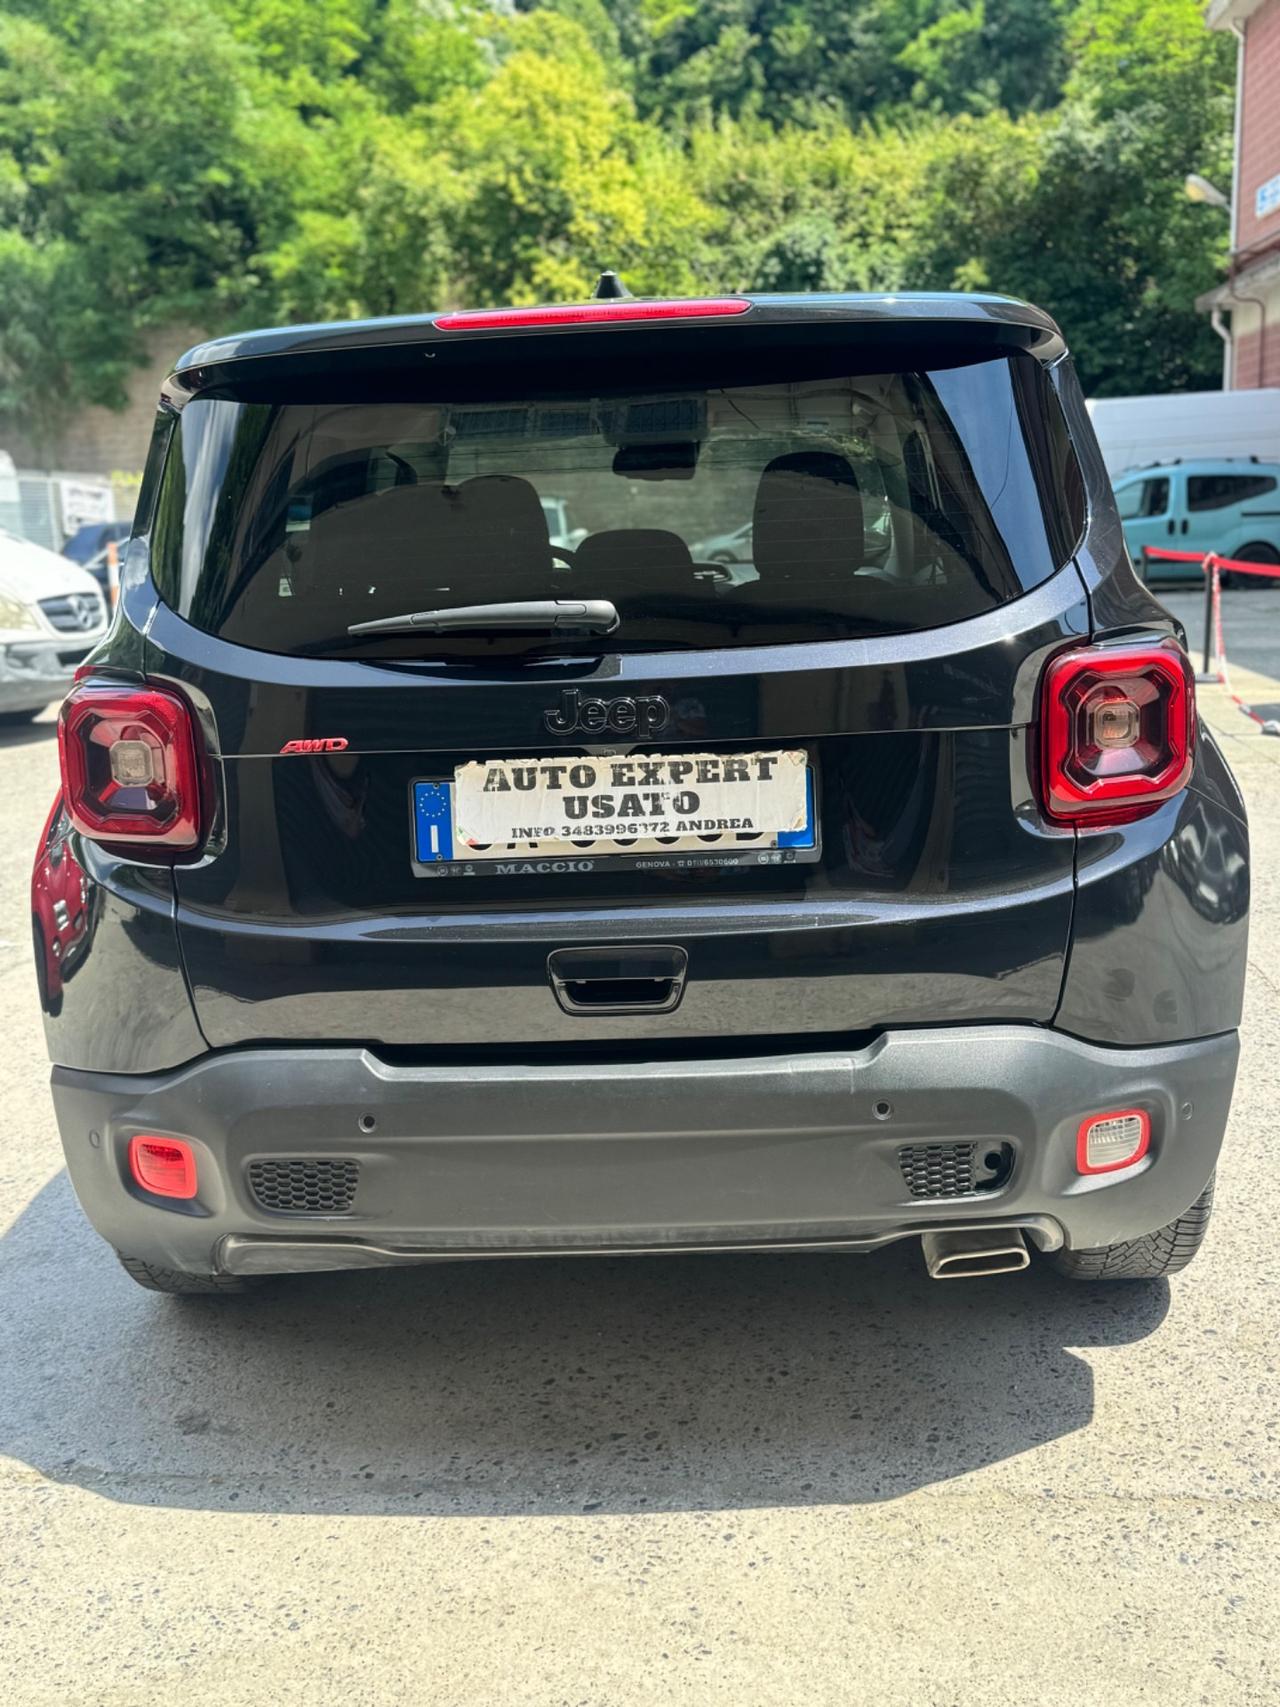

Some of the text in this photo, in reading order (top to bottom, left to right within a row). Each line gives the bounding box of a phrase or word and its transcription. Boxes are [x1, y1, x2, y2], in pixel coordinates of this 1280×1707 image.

[544, 689, 670, 738] Jeep
[280, 738, 348, 753] AWD
[483, 757, 778, 792] AUTO EXPERT
[563, 791, 700, 820] USATO
[511, 827, 555, 838] INFO
[676, 818, 754, 832] ANDREA
[635, 861, 671, 869] GENOVA
